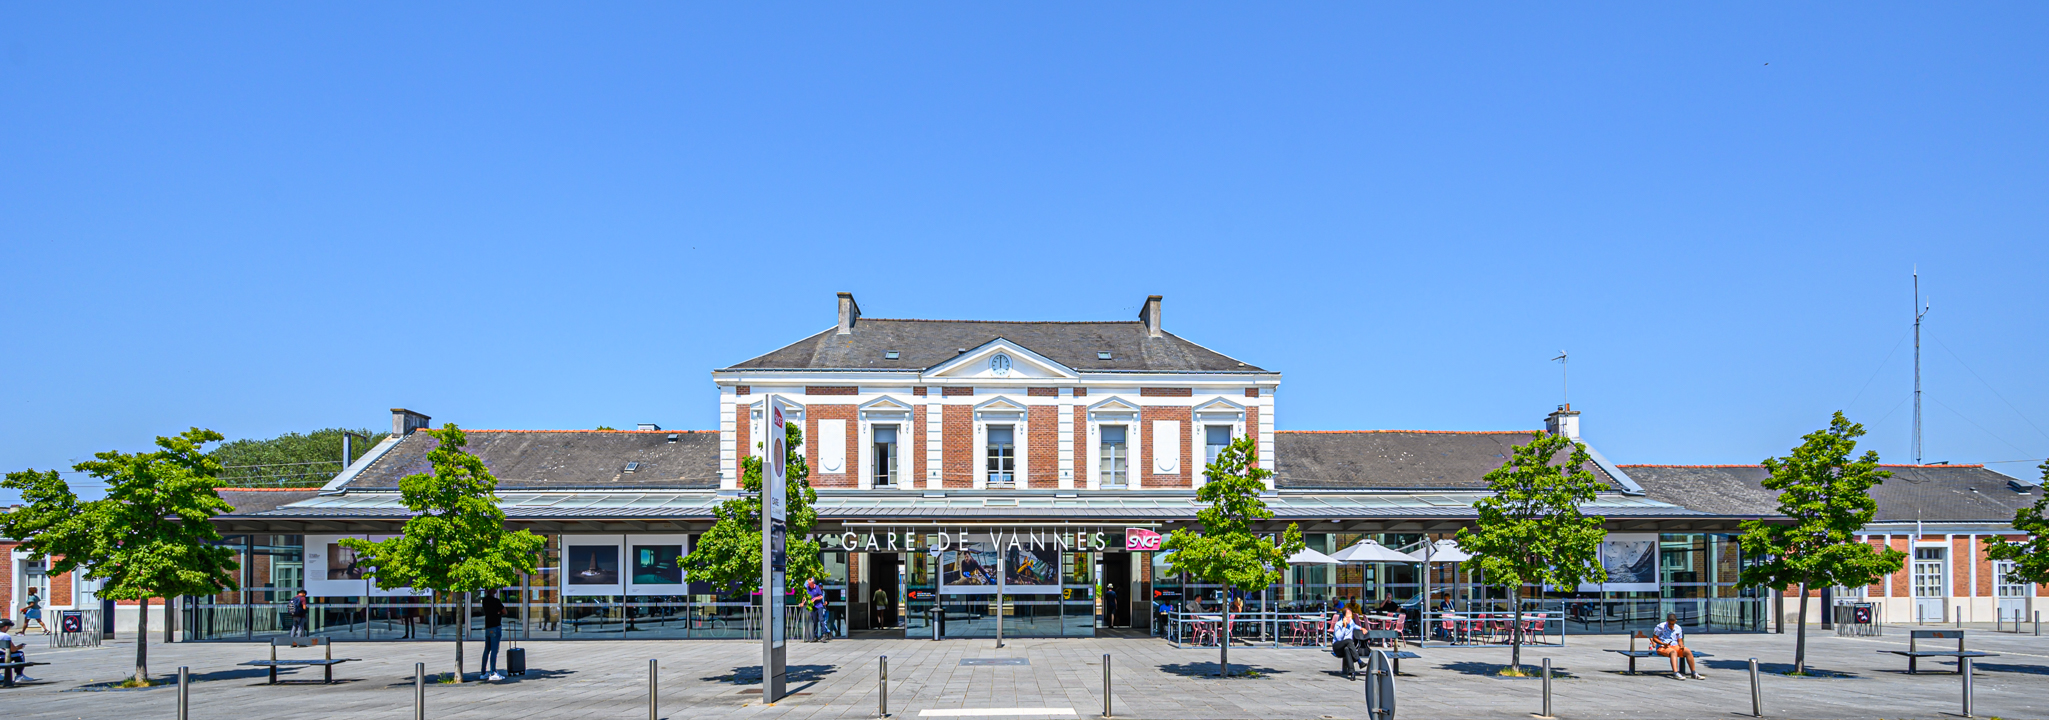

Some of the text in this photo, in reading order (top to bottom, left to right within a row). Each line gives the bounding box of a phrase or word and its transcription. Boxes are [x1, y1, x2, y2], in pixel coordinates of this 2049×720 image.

[841, 531, 1106, 551] GARE DE VANNES
[1128, 535, 1160, 548] SNCF
